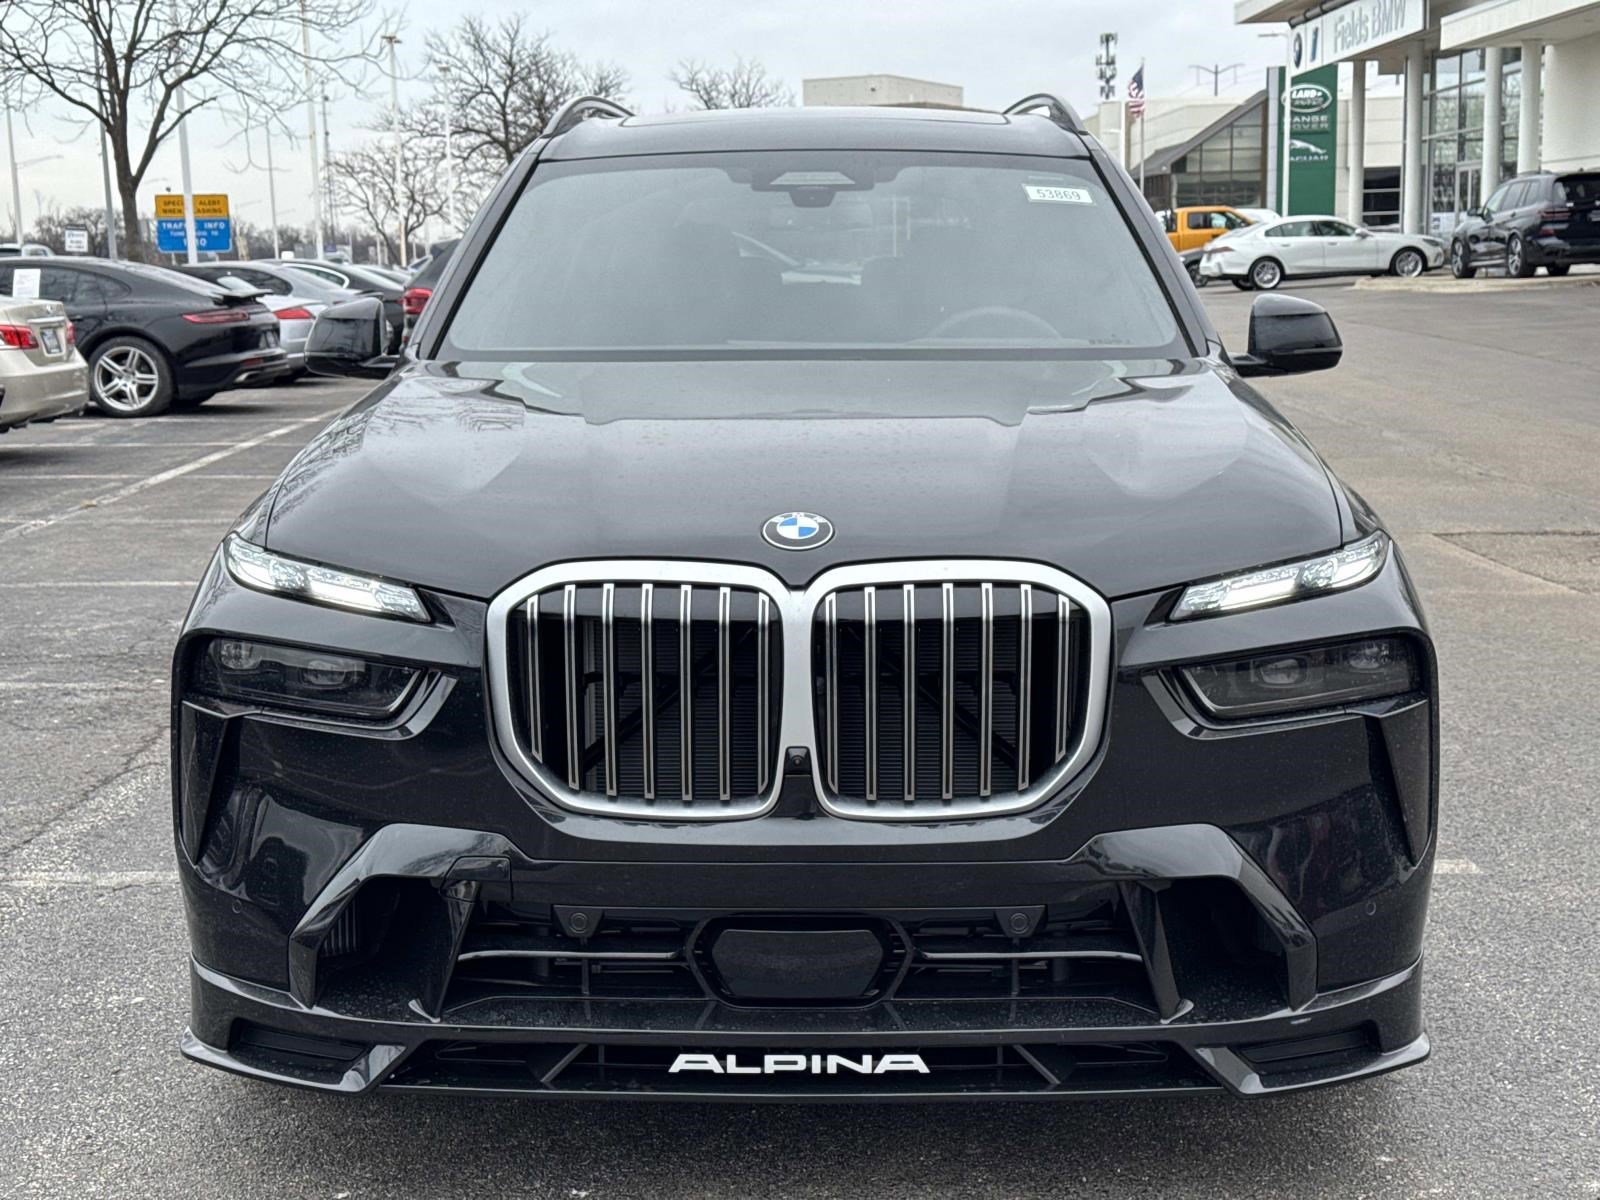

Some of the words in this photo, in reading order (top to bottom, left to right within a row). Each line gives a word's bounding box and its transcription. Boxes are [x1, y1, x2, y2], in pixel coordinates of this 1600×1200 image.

[1334, 7, 1369, 53] Fields
[1371, 0, 1407, 39] BMW
[1292, 89, 1317, 98] LAND
[1036, 188, 1081, 201] 53869
[203, 222, 225, 230] INFO
[668, 1053, 930, 1074] ALPINA
